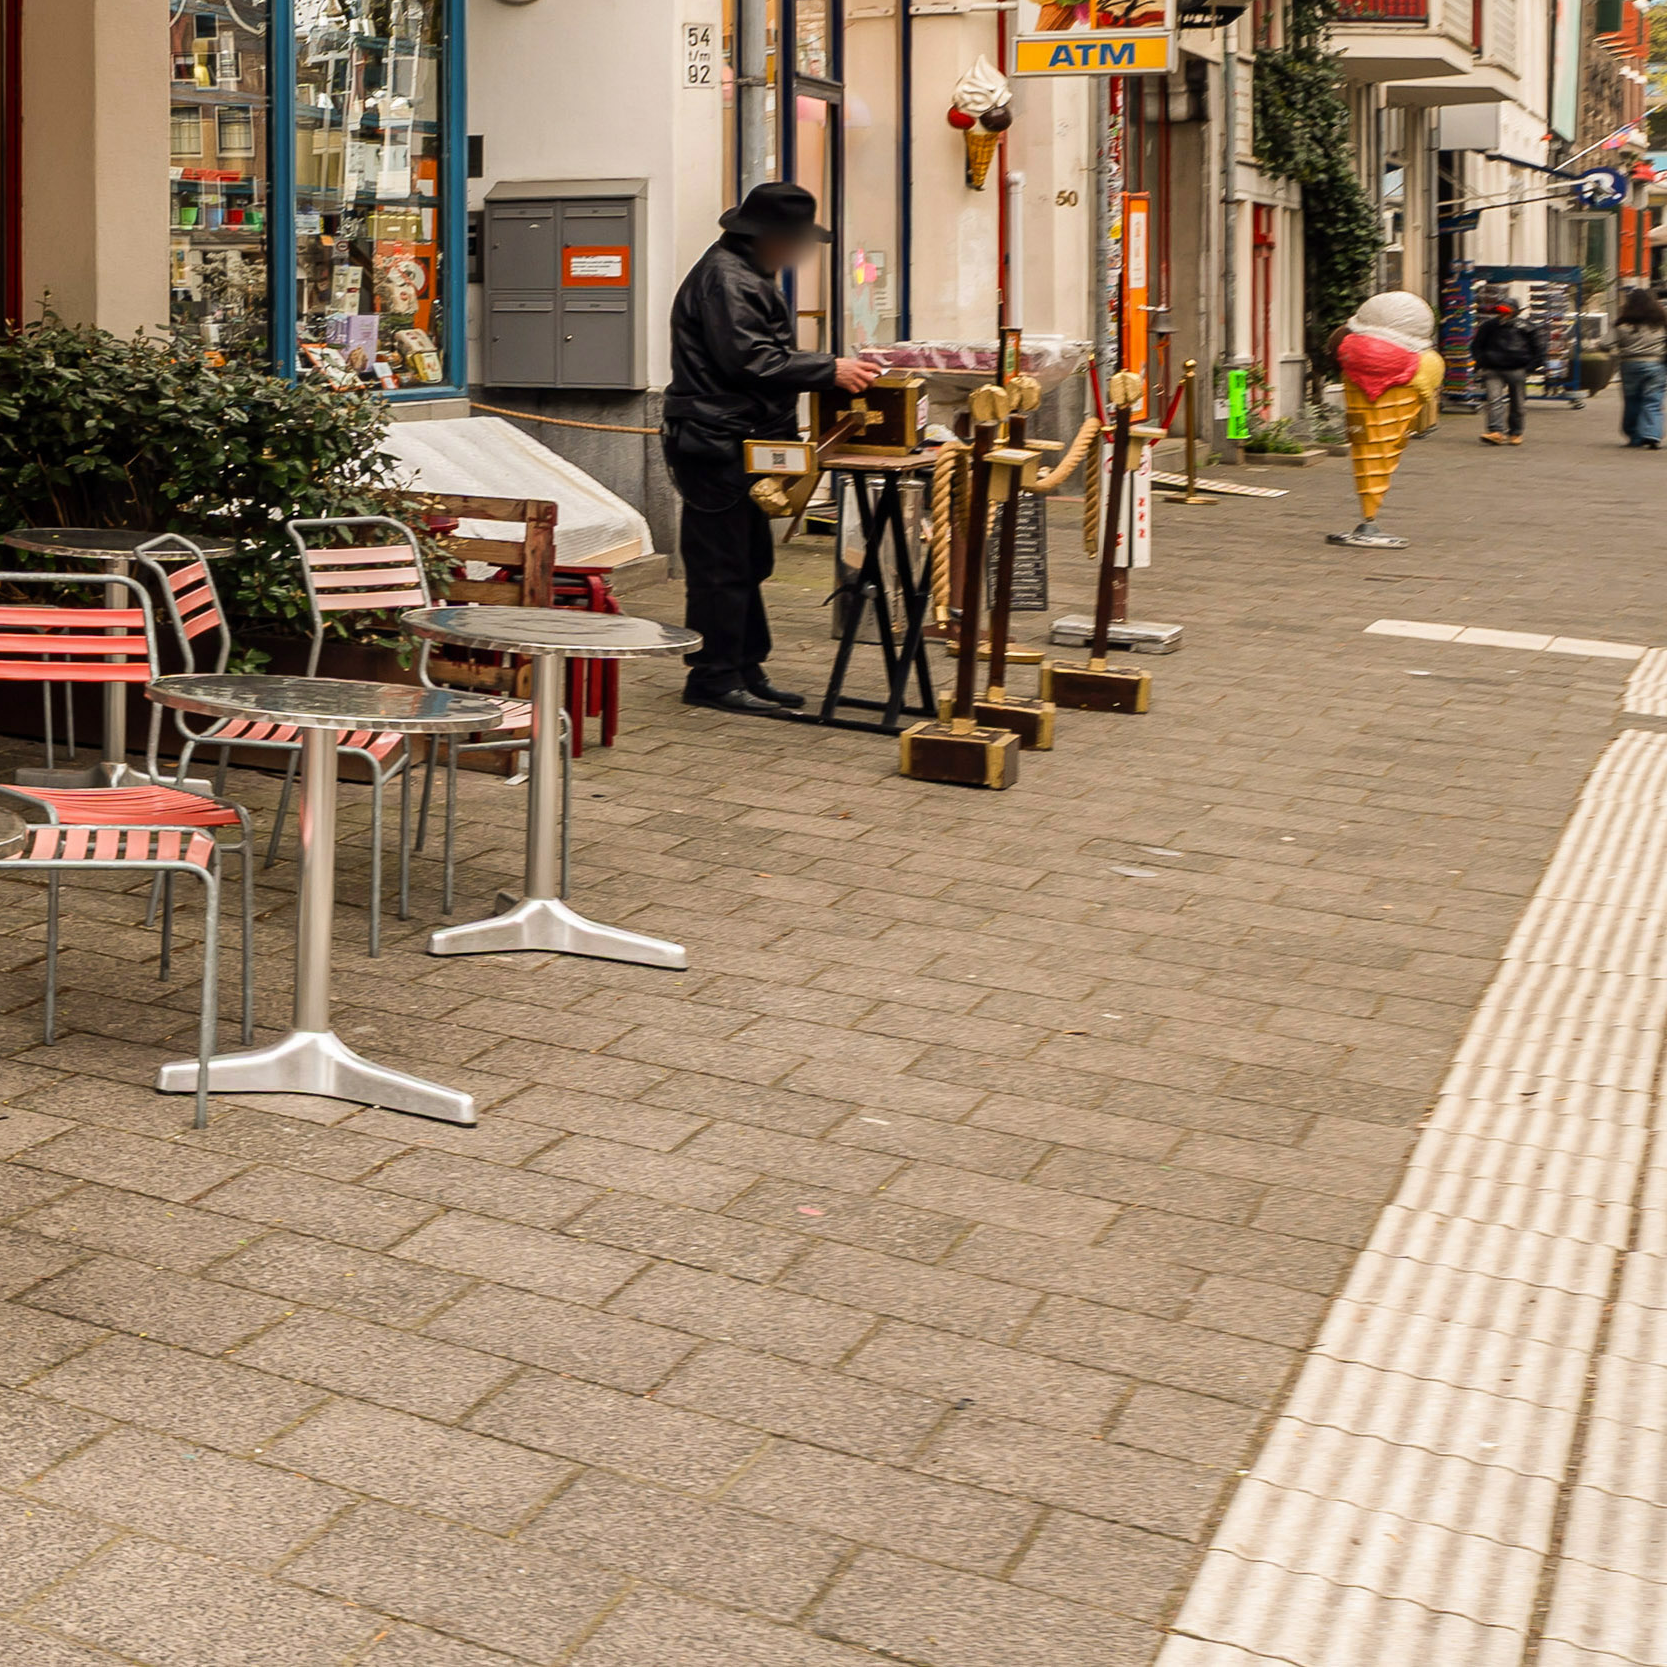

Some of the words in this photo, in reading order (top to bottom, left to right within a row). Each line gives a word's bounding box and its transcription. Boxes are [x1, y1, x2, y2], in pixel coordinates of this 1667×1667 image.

[688, 27, 710, 47] 54
[1048, 43, 1136, 67] ATM
[1055, 190, 1078, 207] 50
